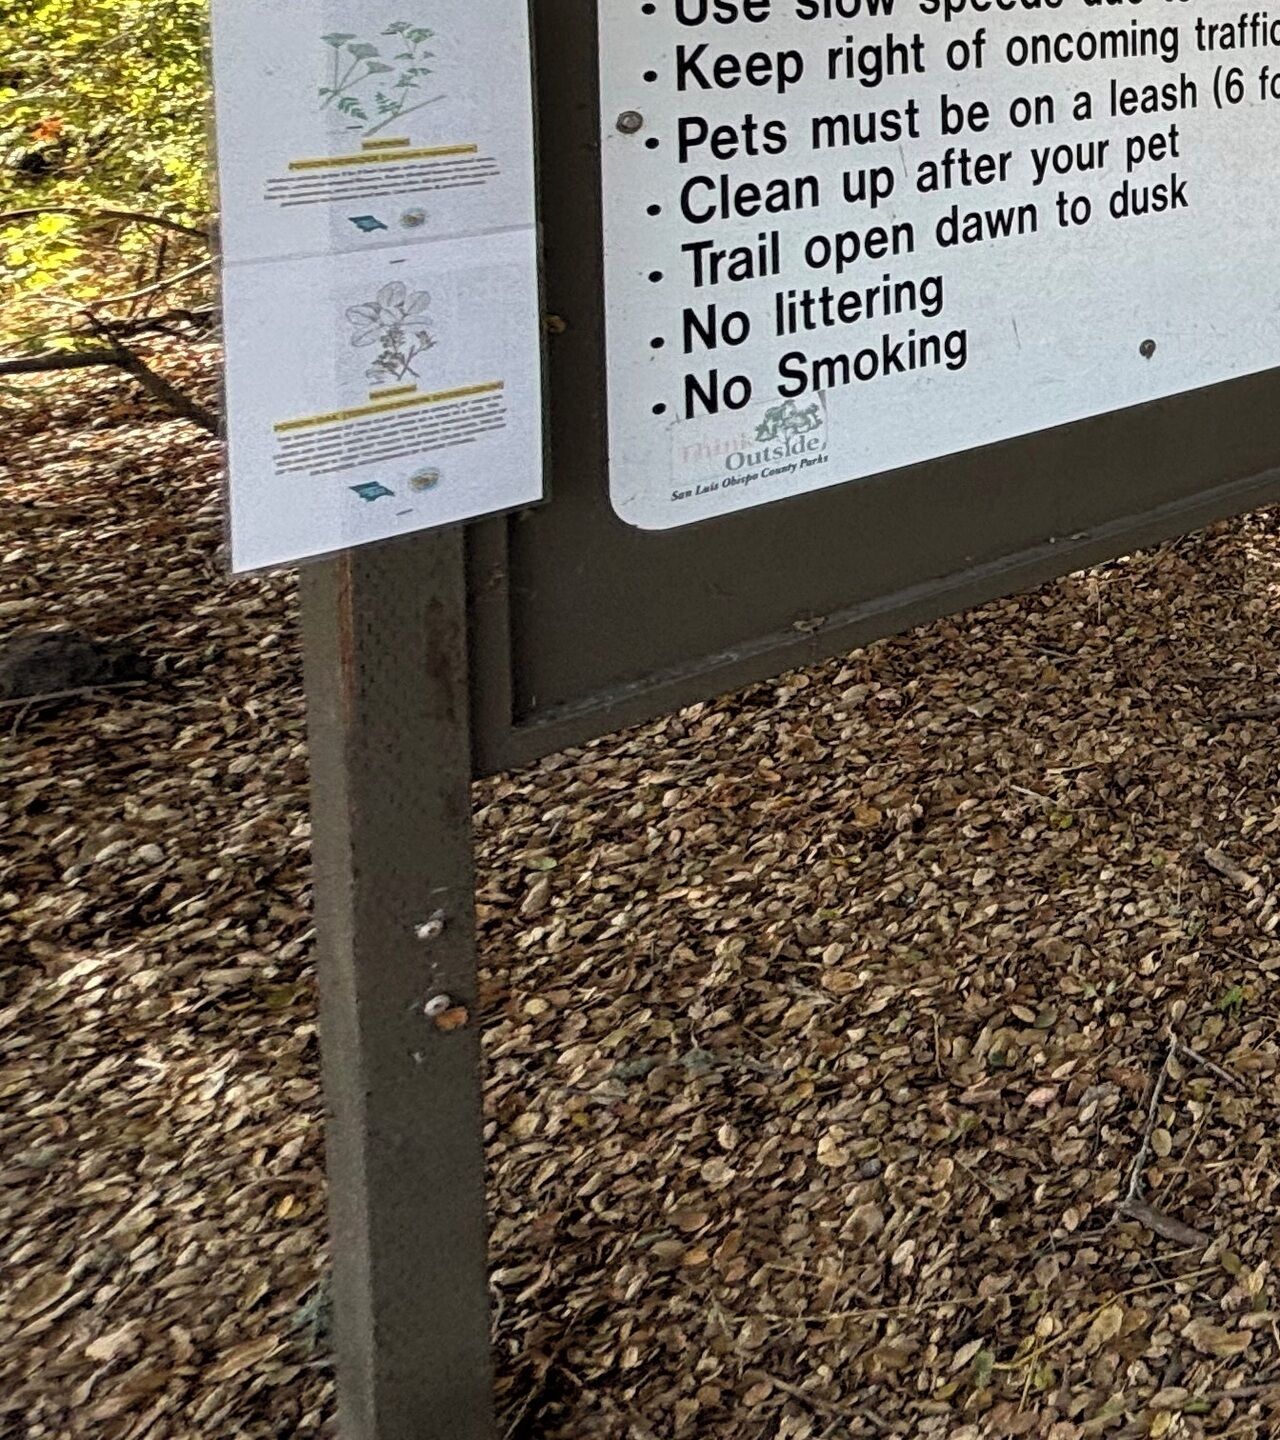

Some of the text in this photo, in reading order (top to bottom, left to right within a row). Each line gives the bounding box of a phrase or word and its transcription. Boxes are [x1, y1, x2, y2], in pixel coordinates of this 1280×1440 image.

[676, 43, 804, 94] Keep
[828, 33, 925, 88] right
[946, 27, 986, 71] of
[1006, 26, 1179, 67] oncoming
[678, 113, 787, 164] Pets
[812, 99, 920, 150] must
[940, 94, 990, 135] be
[1009, 95, 1054, 128] on
[1073, 91, 1092, 121] a
[1110, 72, 1197, 117] leash
[1213, 65, 1244, 109] (6
[680, 123, 1179, 224] Clean up after your pet
[681, 172, 1189, 288] Trail open dawn to dusk
[683, 275, 943, 354] No littering
[684, 329, 967, 420] No Smoking
[671, 453, 829, 502] San Luis Obispo County Parks
